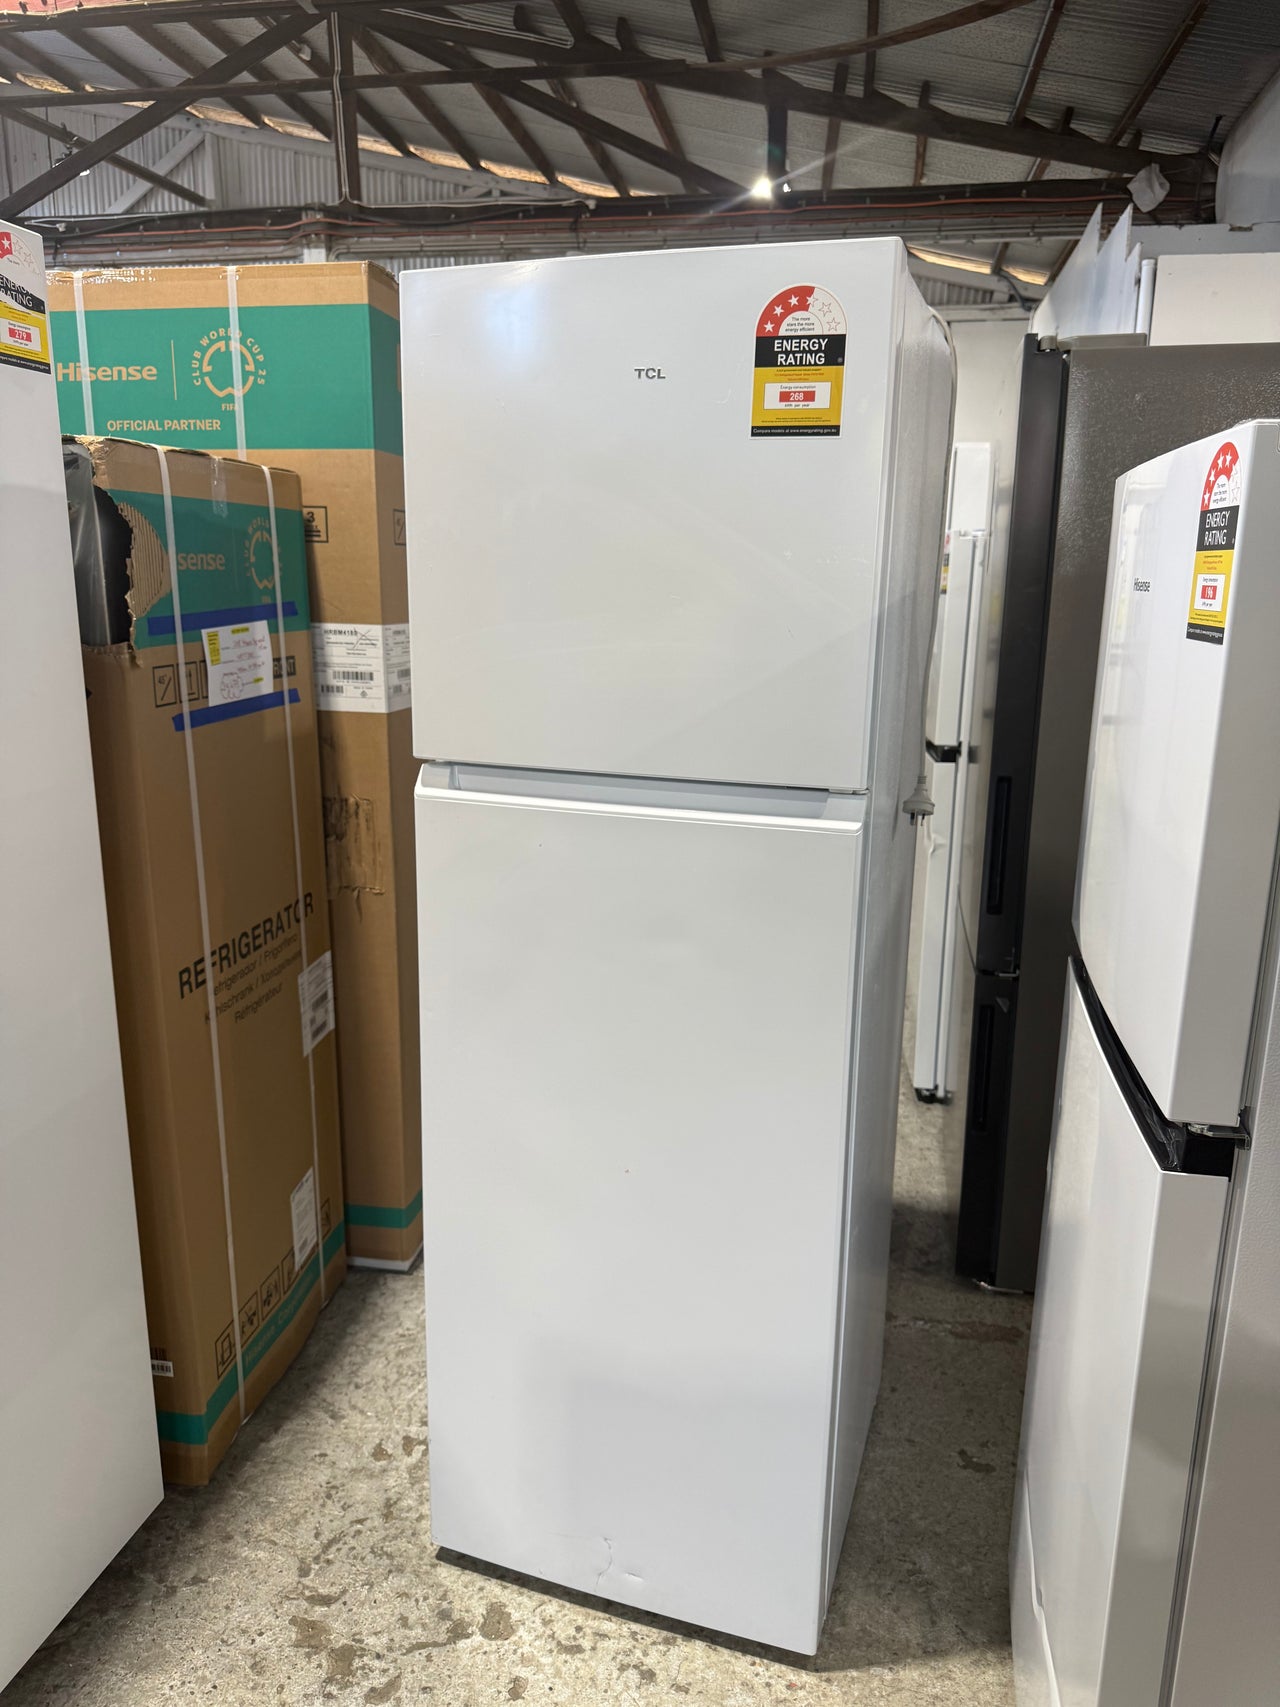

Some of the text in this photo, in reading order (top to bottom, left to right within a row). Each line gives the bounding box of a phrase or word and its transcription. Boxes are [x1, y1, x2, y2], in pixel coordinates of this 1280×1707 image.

[774, 338, 828, 352] ENERGY
[191, 350, 202, 386] CLUB
[246, 337, 265, 362] CUP
[777, 352, 825, 366] RATING
[57, 362, 158, 382] Hisense
[634, 367, 666, 380] TCL
[789, 392, 804, 401] 268
[107, 419, 221, 432] OFFICIAL PARTNER
[1205, 510, 1230, 528] ENERGY
[1203, 529, 1227, 546] RATING
[1133, 577, 1150, 592] Hisense
